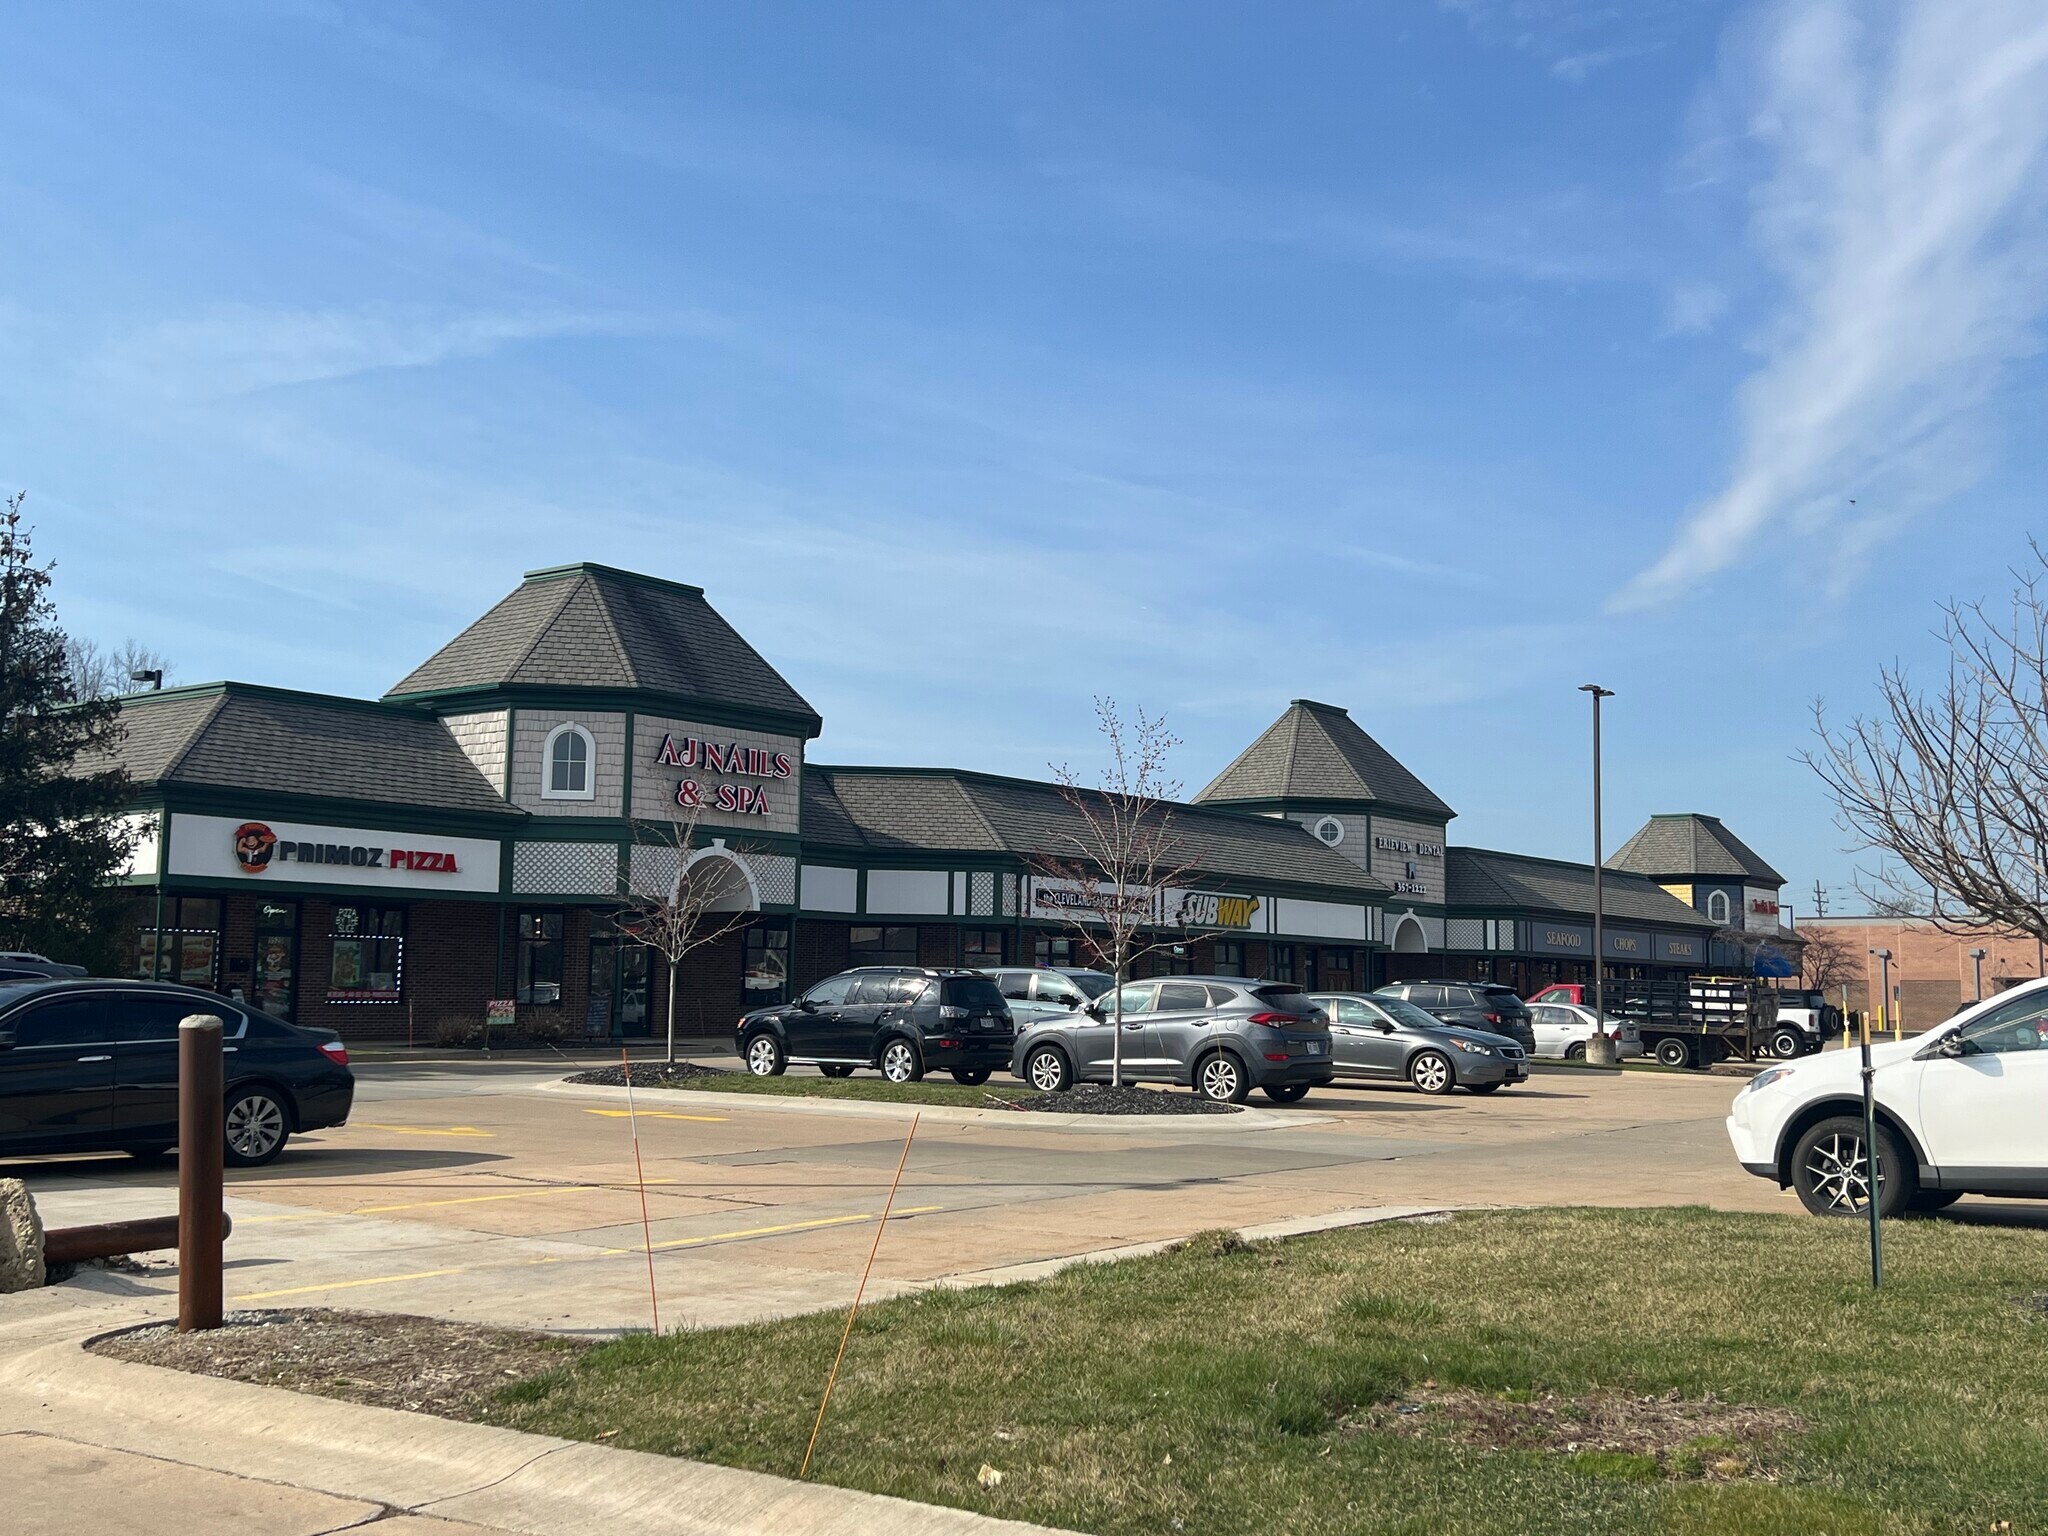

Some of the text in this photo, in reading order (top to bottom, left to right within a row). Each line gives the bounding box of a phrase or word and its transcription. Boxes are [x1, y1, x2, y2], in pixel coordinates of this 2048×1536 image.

[656, 733, 792, 779] AJ NAILS
[676, 779, 772, 815] & SPA
[1378, 837, 1444, 857] ERIEVIEW DENTAL
[279, 841, 458, 873] PRIMOZ PIZZA
[1397, 882, 1427, 894] 357-1222
[263, 905, 288, 918] Open
[1178, 892, 1260, 928] SUBWAY
[1546, 931, 1581, 947] SEAFOOD
[1613, 937, 1637, 952] CHOPS
[1668, 942, 1692, 956] STEAKS
[489, 1000, 514, 1008] PIZZA
